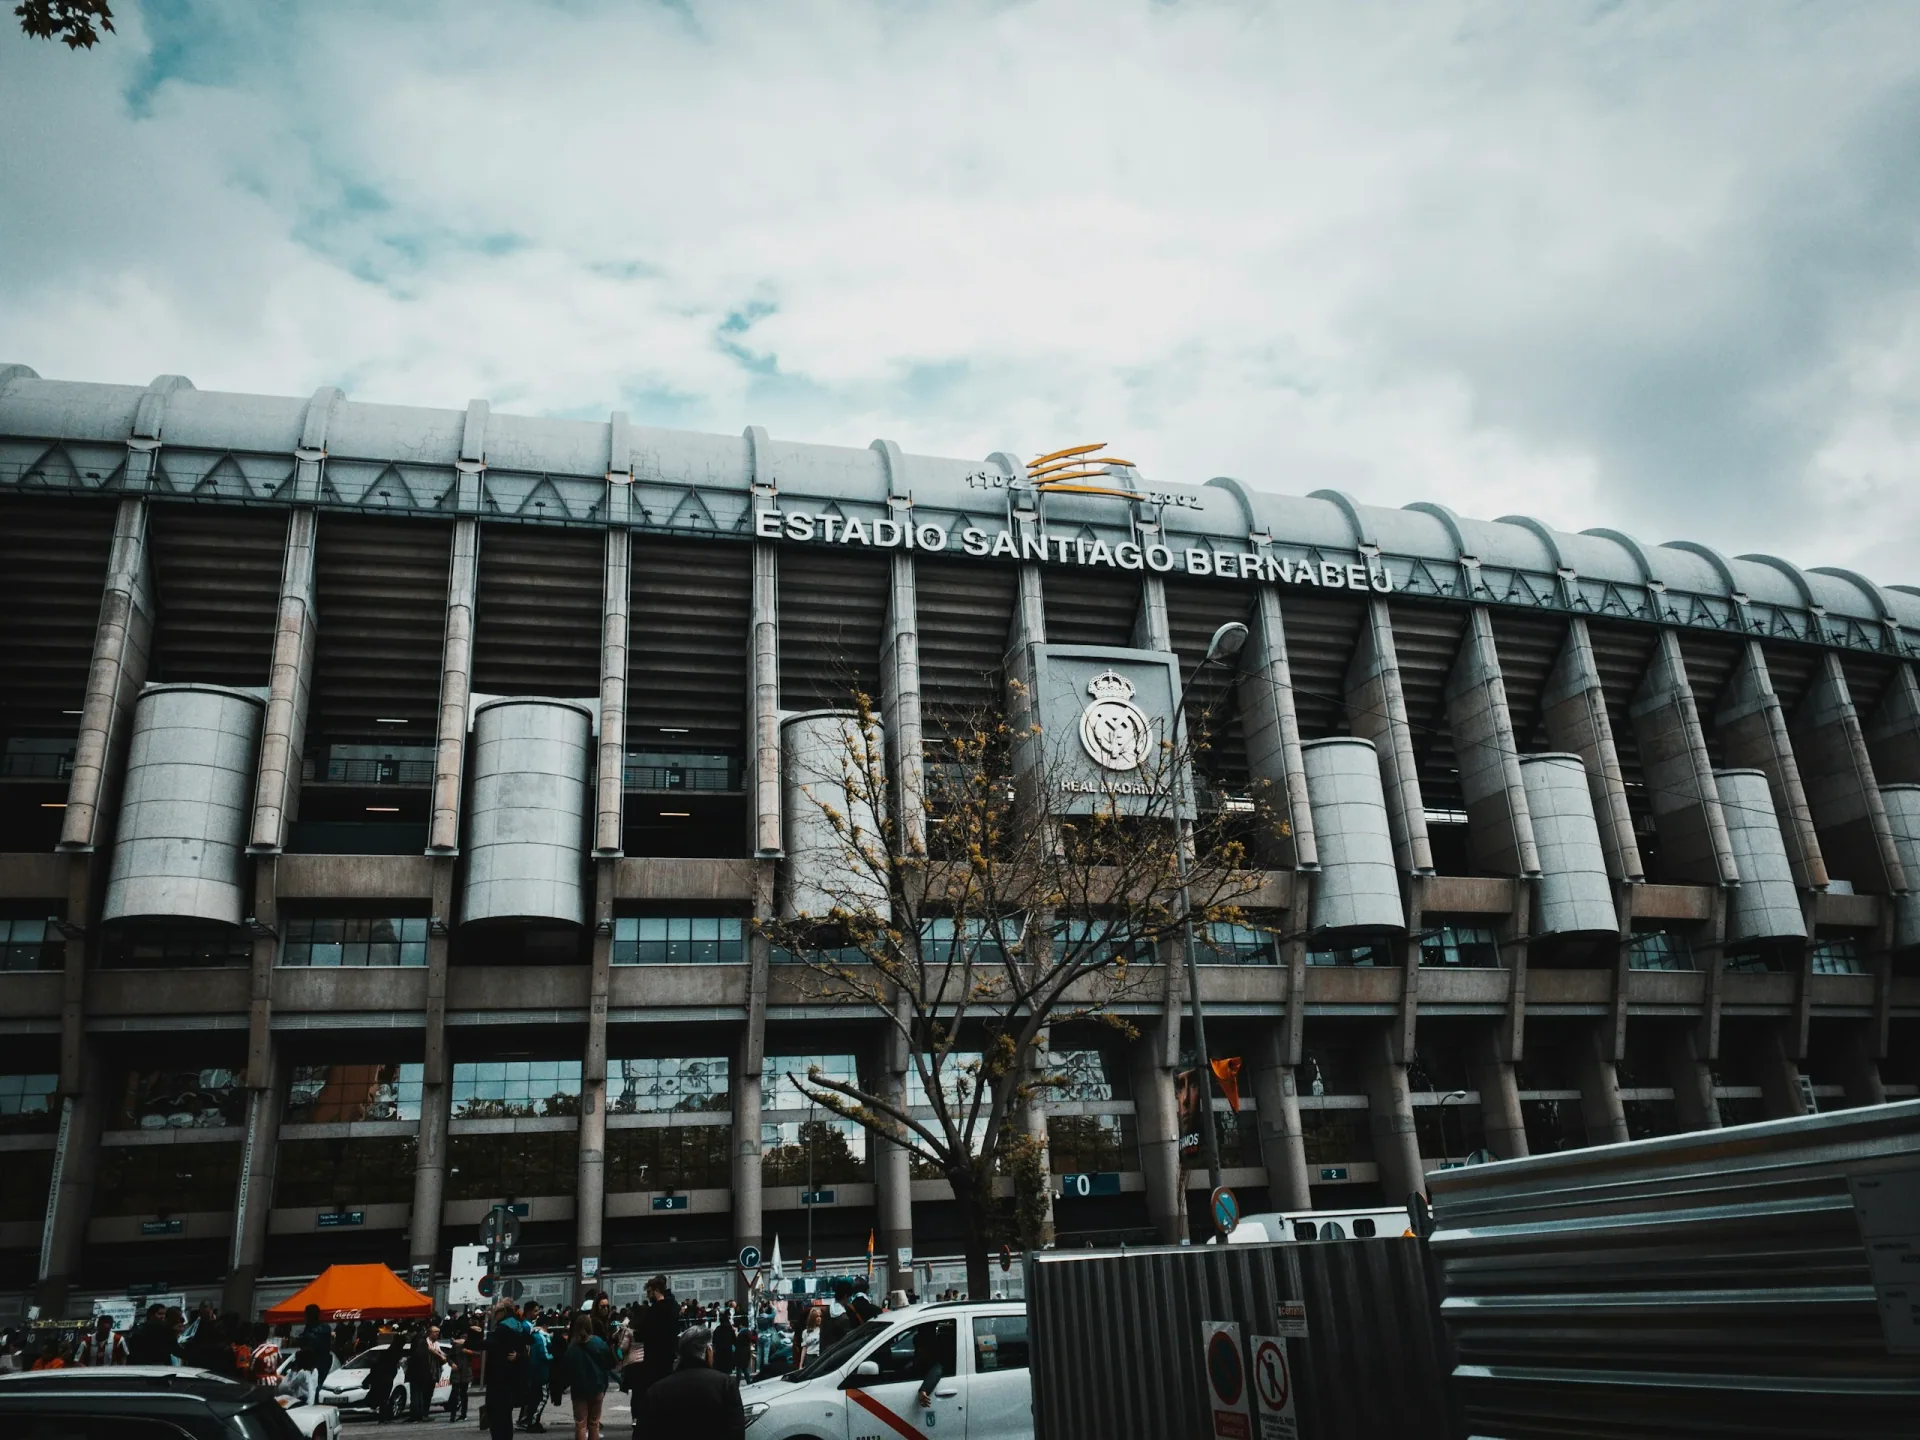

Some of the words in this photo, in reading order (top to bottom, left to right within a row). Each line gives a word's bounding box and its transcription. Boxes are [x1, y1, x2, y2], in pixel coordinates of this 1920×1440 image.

[965, 471, 1022, 491] 1902
[1150, 492, 1204, 511] 2002
[755, 509, 947, 552] ESTADIO
[961, 527, 1175, 572] SANTIAGO
[1184, 547, 1394, 593] BERNABEU
[1061, 781, 1097, 794] REAL
[1100, 781, 1155, 796] MADRID
[1331, 1169, 1337, 1179] 2
[1077, 1174, 1090, 1196] 0
[666, 1198, 673, 1208] 3
[814, 1192, 820, 1202] 1
